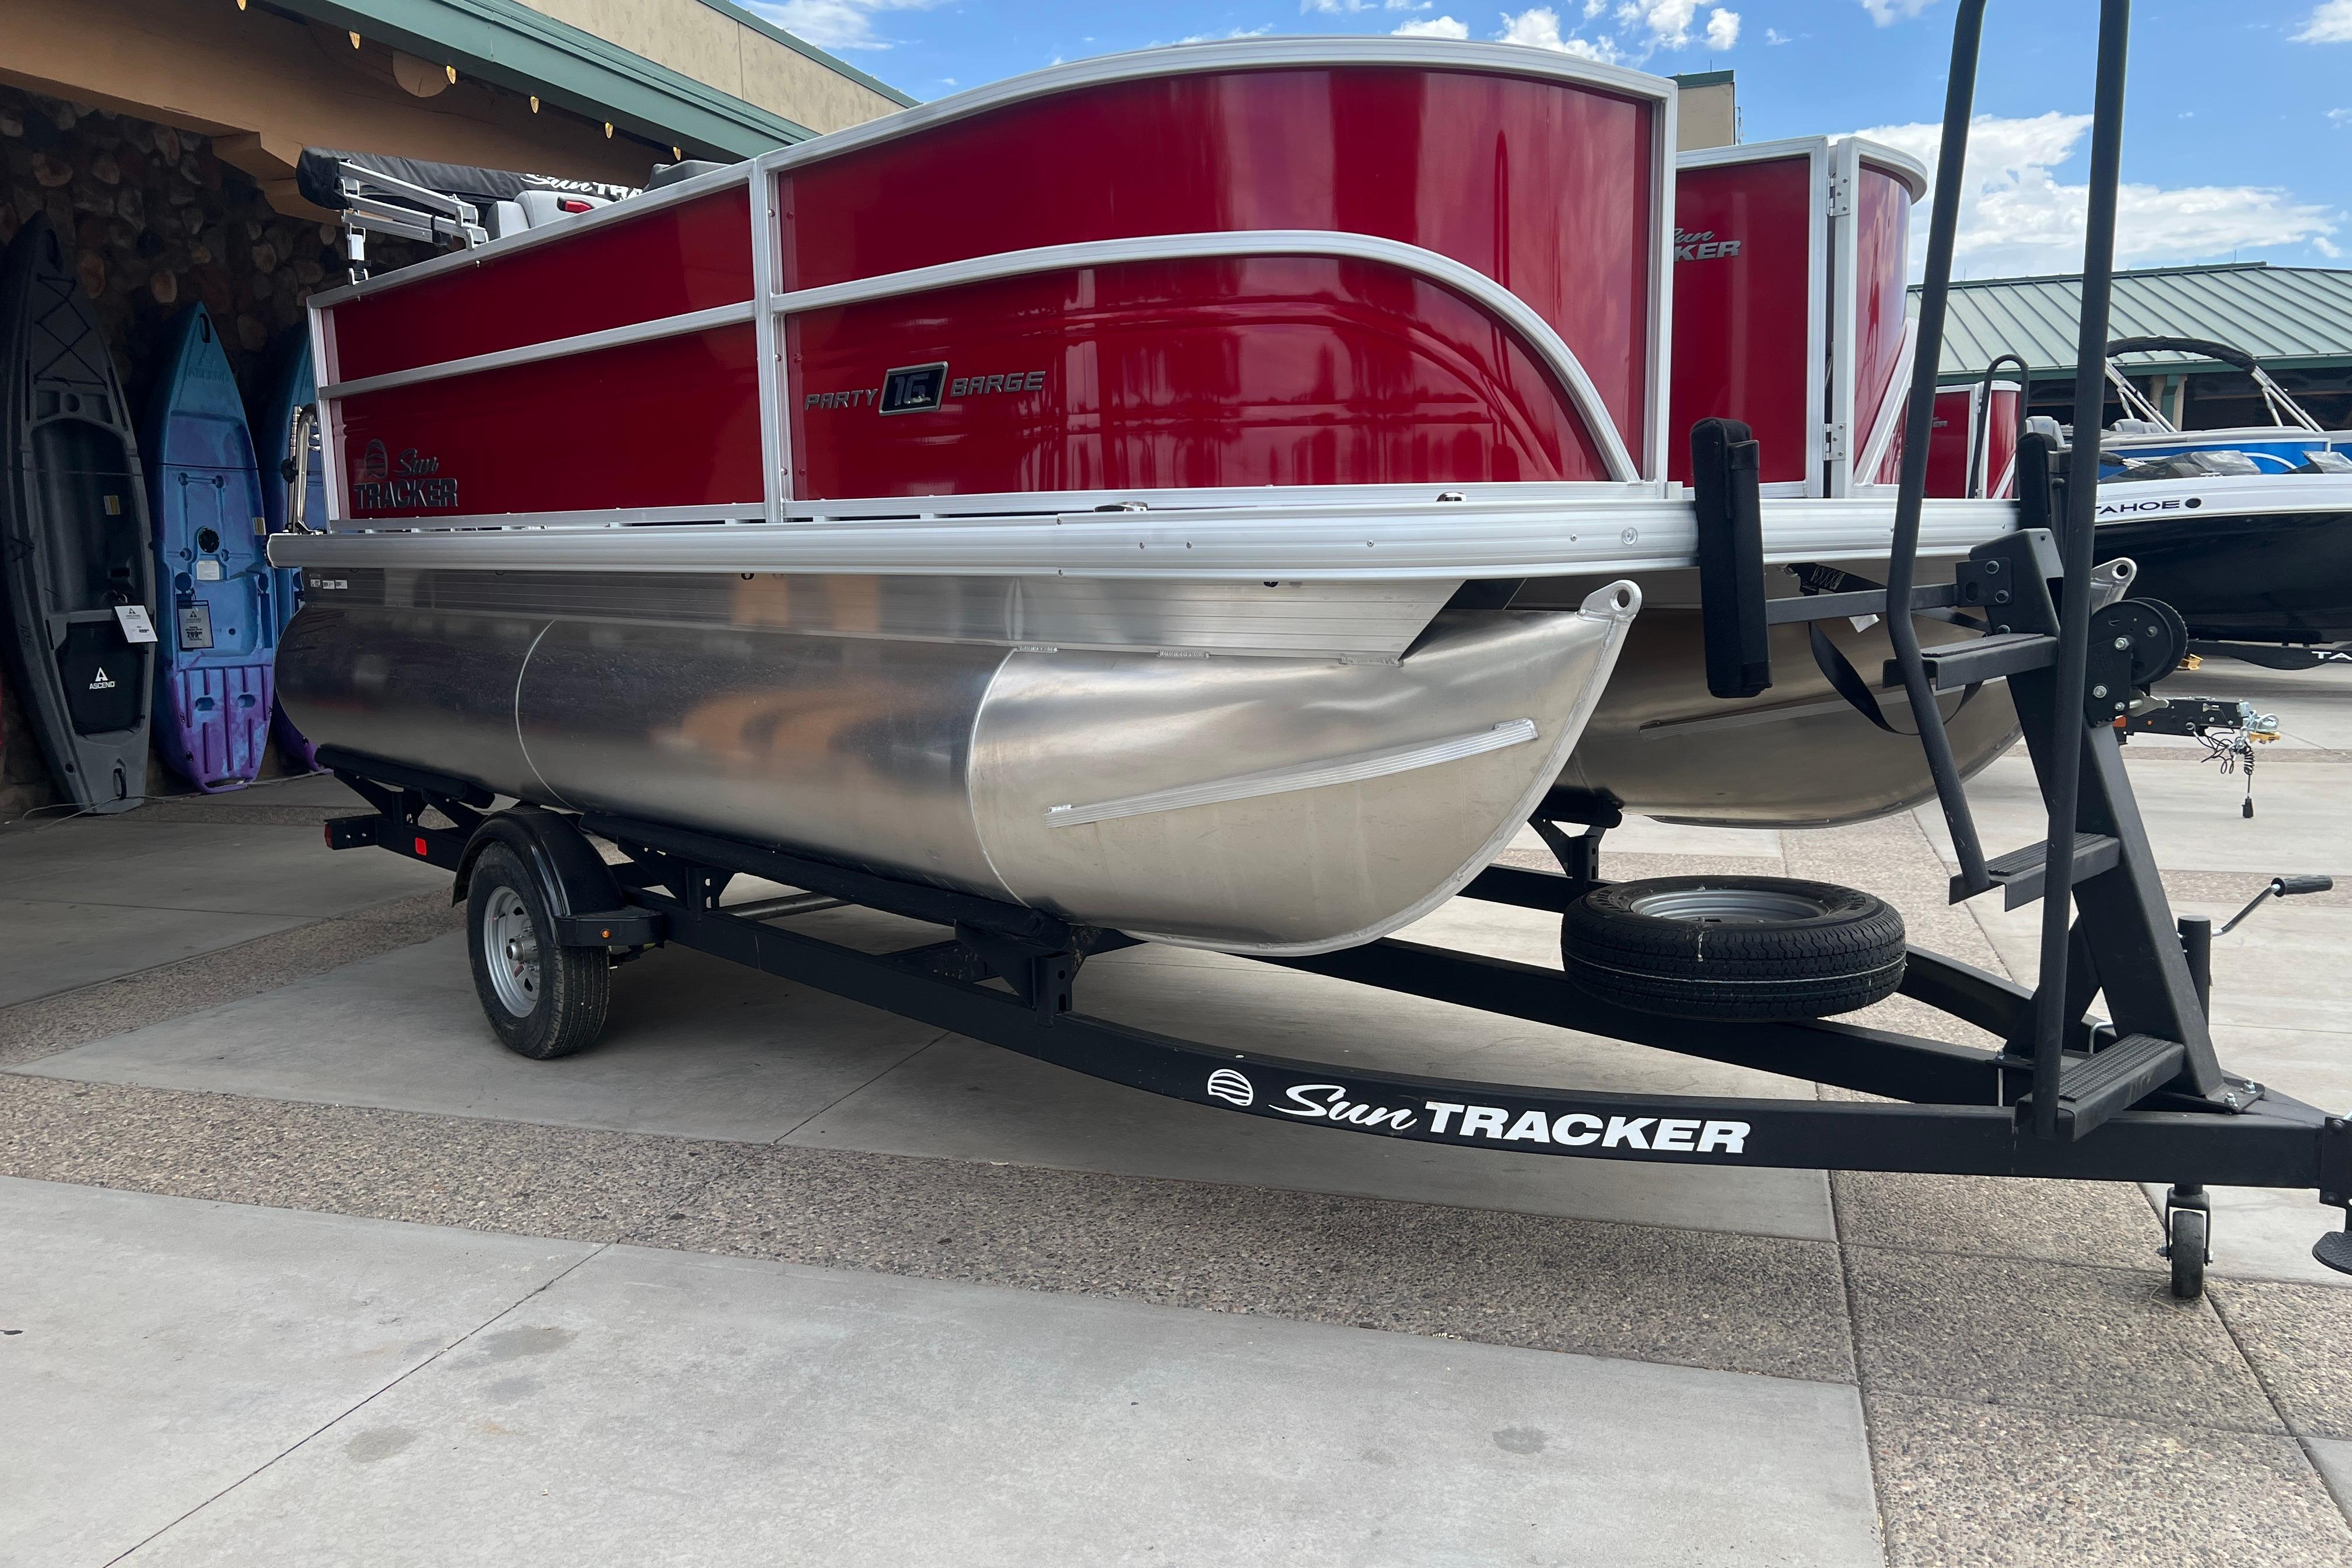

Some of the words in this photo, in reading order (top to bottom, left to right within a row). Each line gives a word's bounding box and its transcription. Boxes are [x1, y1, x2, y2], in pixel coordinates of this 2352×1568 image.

[520, 173, 593, 192] Sun
[804, 388, 878, 411] PARTY
[894, 372, 930, 406] 16
[950, 370, 1046, 397] BARGE
[393, 448, 439, 476] Sun
[354, 478, 458, 510] TRACKER
[89, 681, 116, 690] ASCEND
[1269, 1084, 1418, 1130] Sun
[1425, 1101, 1751, 1154] TRACKER
